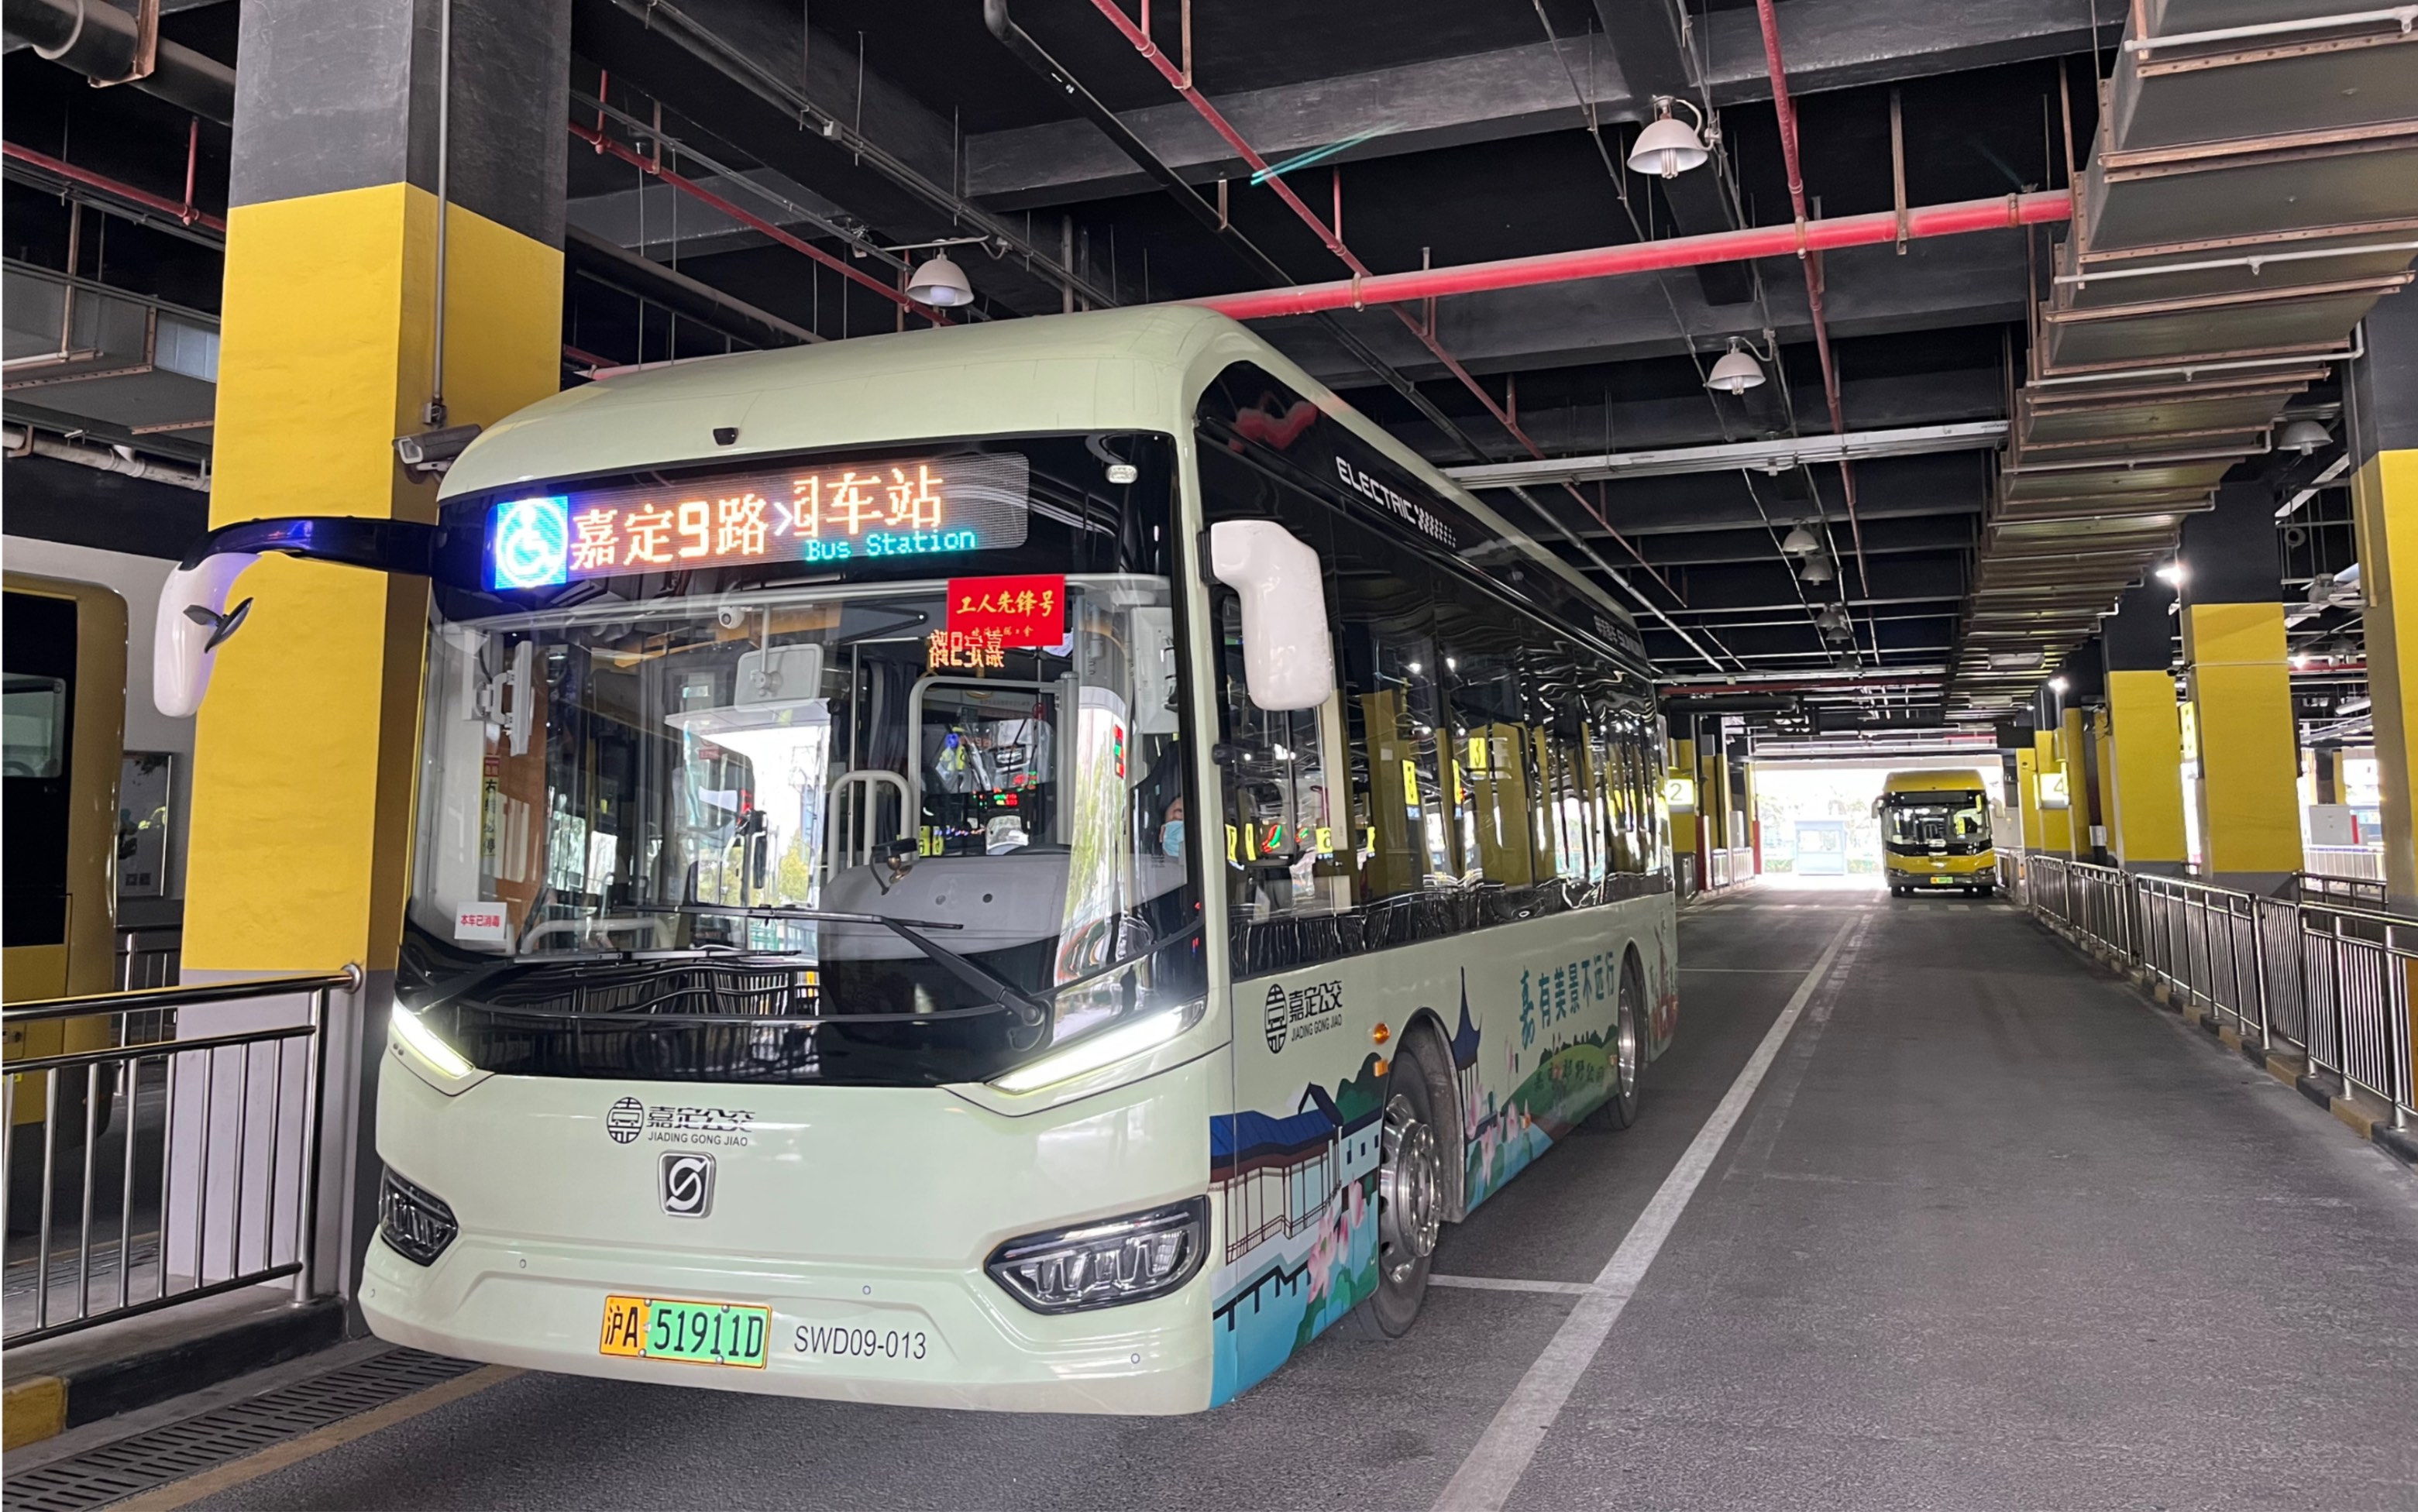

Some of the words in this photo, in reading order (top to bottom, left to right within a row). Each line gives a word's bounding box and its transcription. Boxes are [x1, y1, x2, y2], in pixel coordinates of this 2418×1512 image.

[1336, 455, 1416, 524] ELECTRIC
[569, 493, 769, 570] 嘉定9路
[806, 538, 851, 562] Bus
[865, 528, 976, 557] Station
[956, 589, 1054, 617] 工人先锋号
[1670, 782, 1683, 801] 2
[460, 914, 500, 927] 本车已消毒
[1288, 979, 1343, 1023] 嘉定公交
[1519, 951, 1615, 1051] 嘉有美景不远行
[1291, 1022, 1314, 1042] JIADING
[1314, 1016, 1330, 1035] GONG
[646, 1105, 756, 1133] 嘉定公交
[648, 1131, 689, 1143] JIADING
[690, 1133, 721, 1146] GONG
[724, 1136, 748, 1147] JIAO
[794, 1325, 927, 1359] SWD09-013
